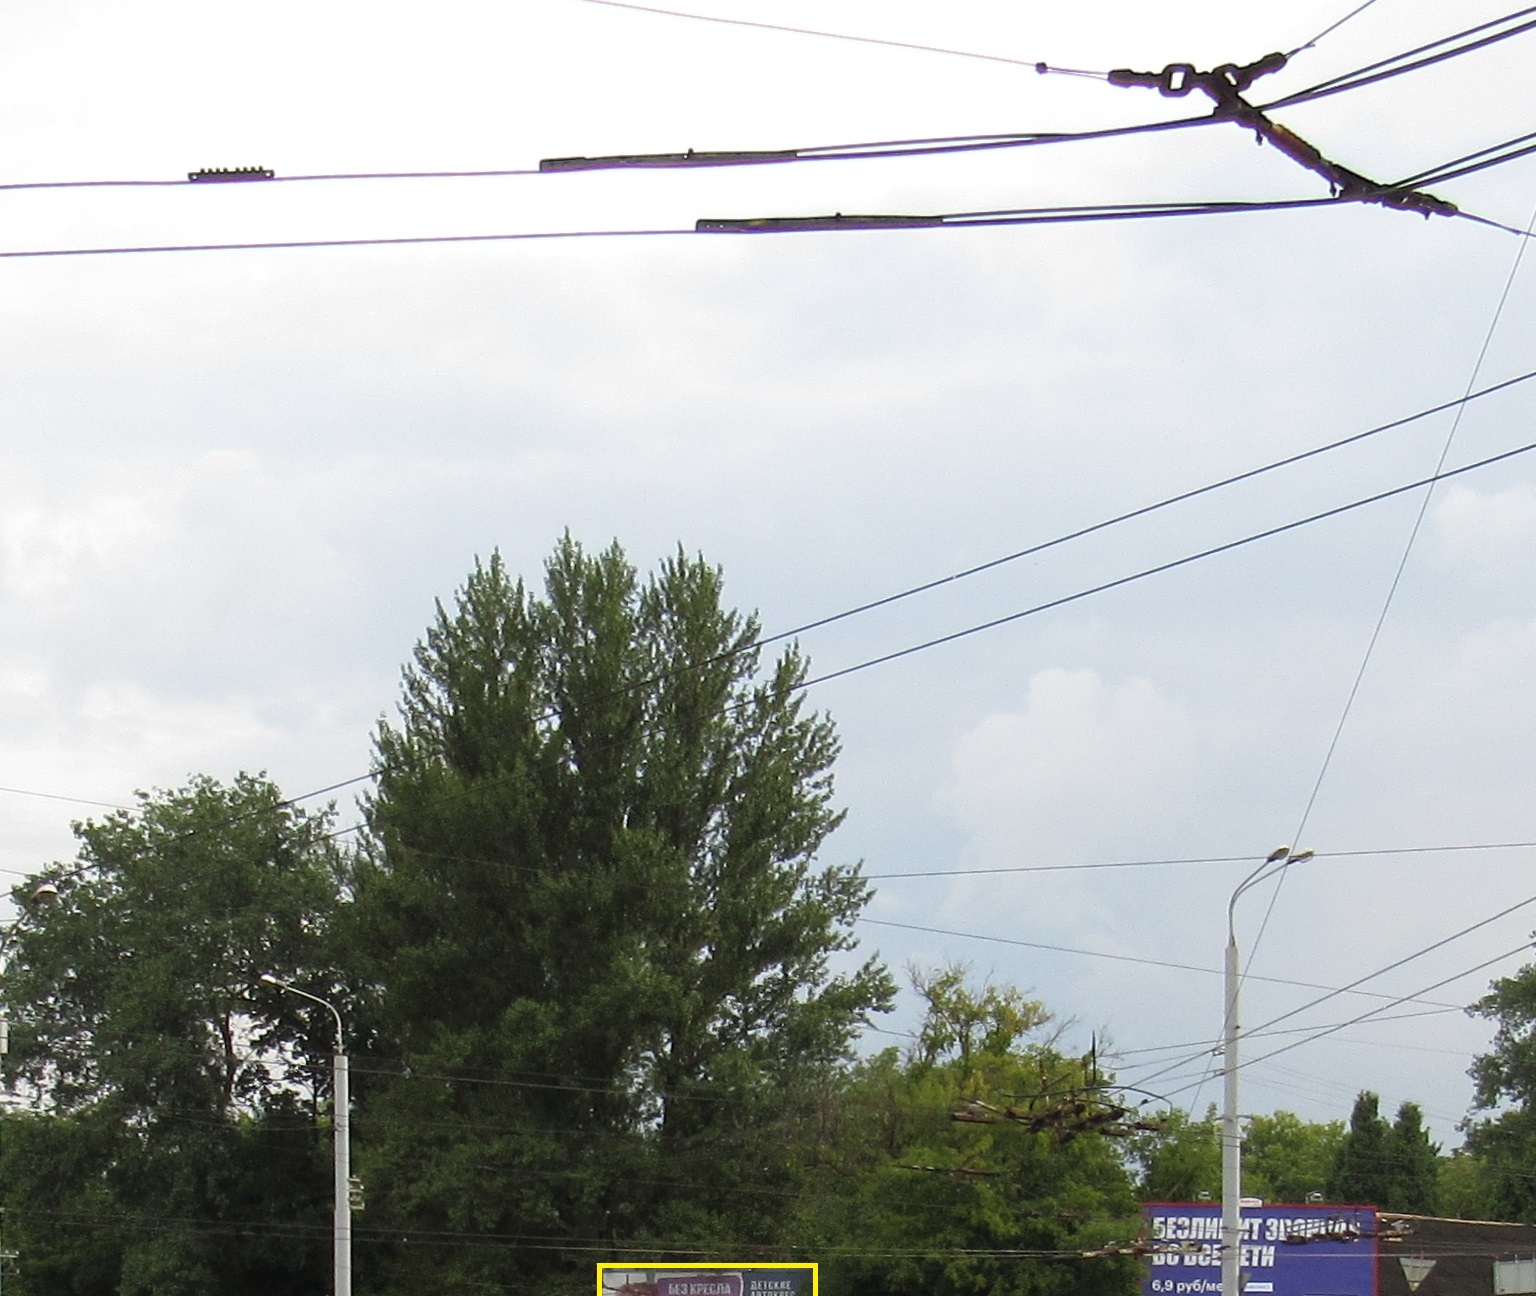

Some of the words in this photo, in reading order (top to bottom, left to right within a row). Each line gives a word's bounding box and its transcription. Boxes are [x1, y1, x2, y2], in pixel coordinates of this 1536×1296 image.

[1153, 1216, 1262, 1240] БЕЗЛИИТ
[1229, 1244, 1275, 1267] ЕТИ
[669, 1283, 688, 1294] БЕЗ
[690, 1283, 731, 1294] КРЕСЛА
[1152, 1280, 1174, 1292] 6,9
[1176, 1279, 1224, 1293] руб/ме
